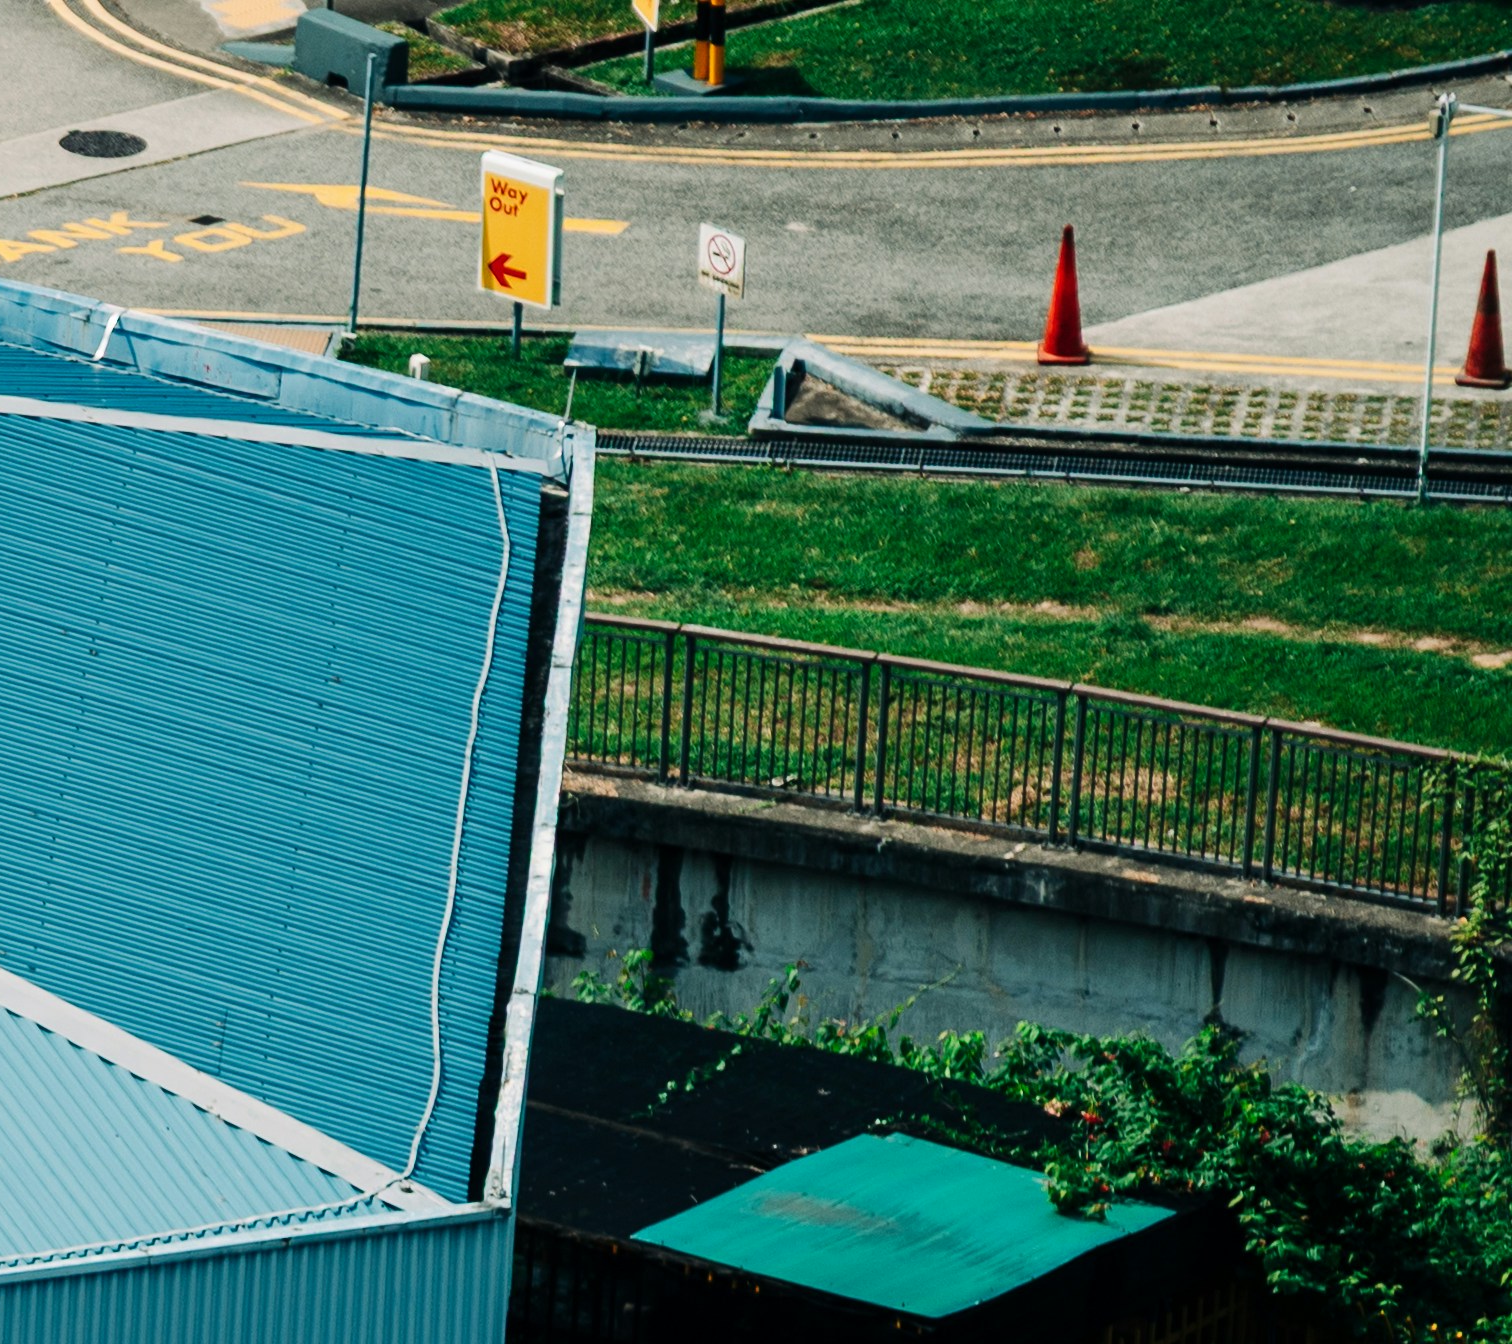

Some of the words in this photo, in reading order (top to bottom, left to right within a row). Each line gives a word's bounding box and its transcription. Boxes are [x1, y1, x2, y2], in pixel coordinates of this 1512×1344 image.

[491, 178, 528, 205] Way
[489, 197, 518, 217] Out
[116, 214, 307, 263] YOU
